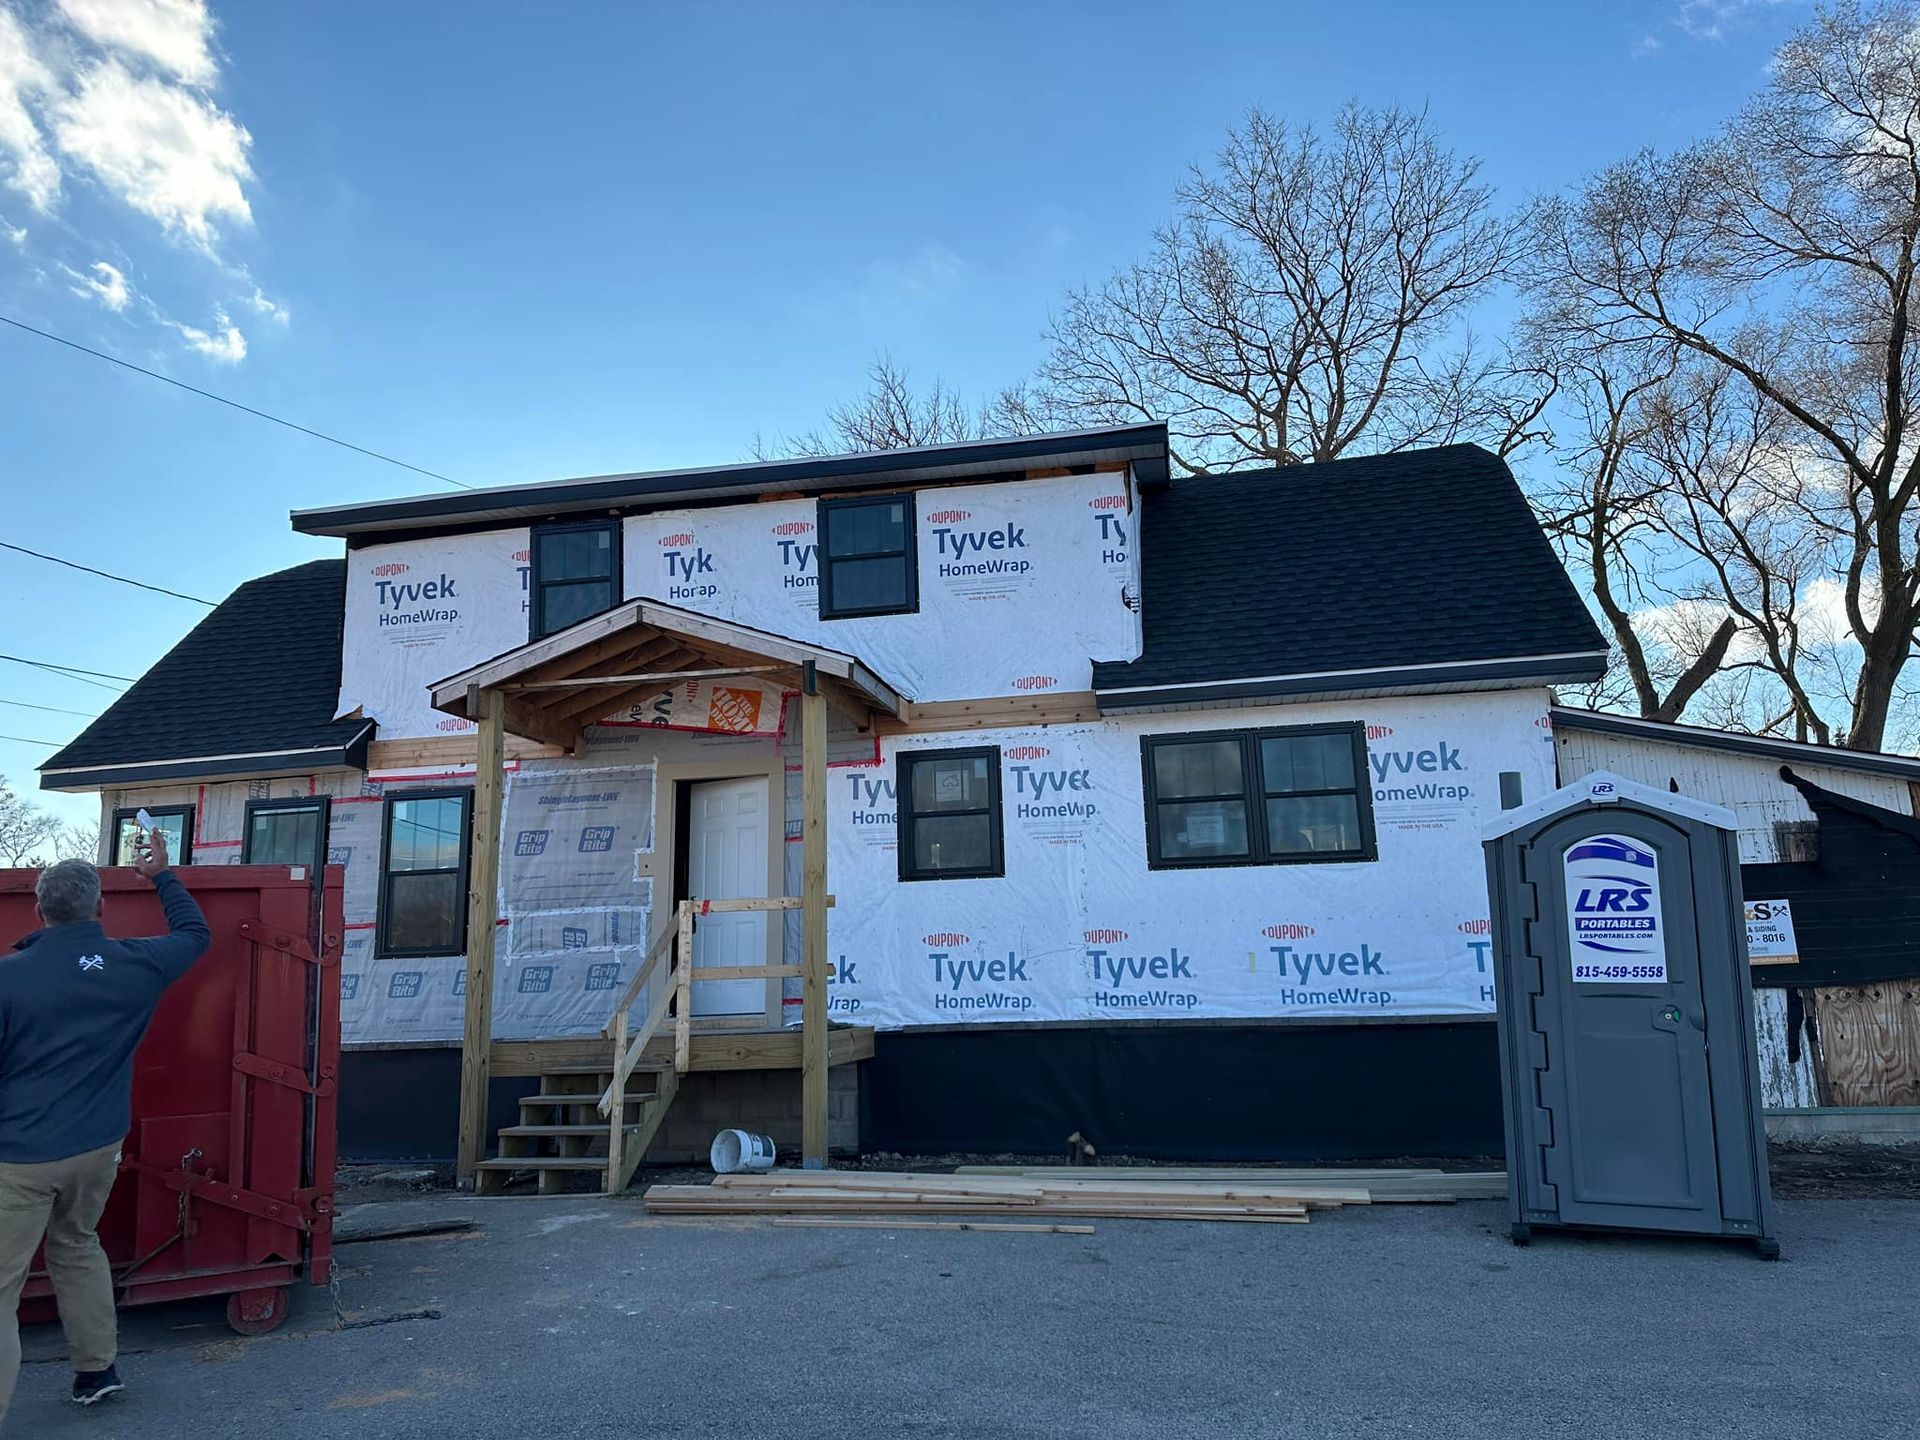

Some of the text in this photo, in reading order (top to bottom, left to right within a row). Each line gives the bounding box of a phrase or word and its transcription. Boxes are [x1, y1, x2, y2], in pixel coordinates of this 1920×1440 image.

[930, 510, 967, 524] DUPONT
[776, 522, 811, 536] DUPONT
[932, 522, 1026, 561] Tyvek
[375, 563, 406, 577] DUPONT
[939, 559, 1030, 578] HomeWrap
[375, 573, 456, 611] Tyvek
[379, 608, 459, 627] HomeWrap
[1016, 675, 1054, 690] DUPONT
[1009, 746, 1045, 760] DUPONT
[1592, 785, 1615, 793] LRS
[520, 832, 546, 844] Grip
[584, 828, 611, 841] Grip
[518, 843, 542, 855] Rite
[582, 840, 607, 851] Rite
[1575, 888, 1653, 912] LRS
[1580, 919, 1651, 928] PORTABLES
[1084, 929, 1123, 944] DUPONT
[1268, 924, 1310, 940] DUPONT
[1762, 933, 1786, 942] 8016
[928, 933, 966, 948] DUPONT
[591, 965, 617, 978] Grip
[928, 951, 1028, 990] Tyvek
[1086, 948, 1192, 988] Tyvek
[1270, 943, 1385, 986] Tyvek
[1576, 965, 1664, 978] 815-459-5558
[394, 974, 419, 987] Grip
[523, 968, 550, 981] Grip
[521, 980, 546, 992] Rite
[589, 977, 613, 989] Rite
[392, 985, 415, 997] Rite
[1281, 988, 1392, 1008] HomeWrap
[935, 993, 1032, 1011] HomeWrap
[1095, 990, 1197, 1009] HomeWrap
